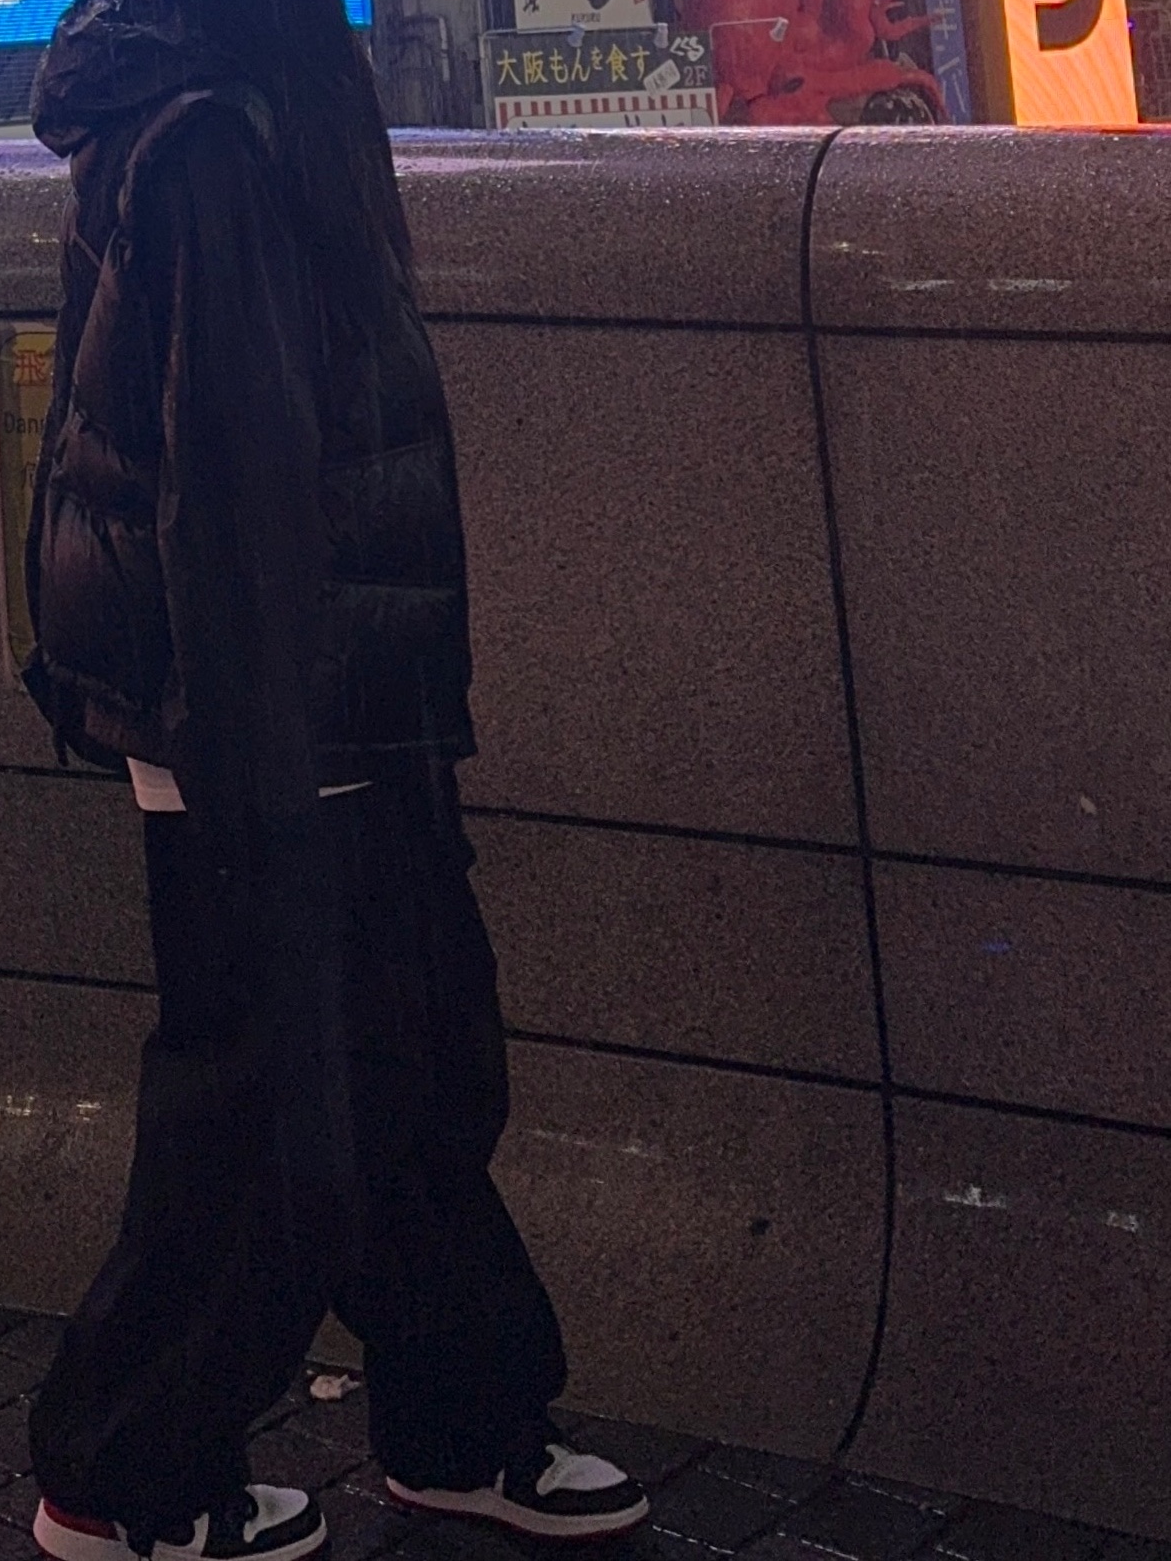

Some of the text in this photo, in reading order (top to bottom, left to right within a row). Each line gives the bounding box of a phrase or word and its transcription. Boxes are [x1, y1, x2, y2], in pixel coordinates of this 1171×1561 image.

[496, 44, 650, 86] 大阪もんを食す
[3, 411, 45, 435] Dan
